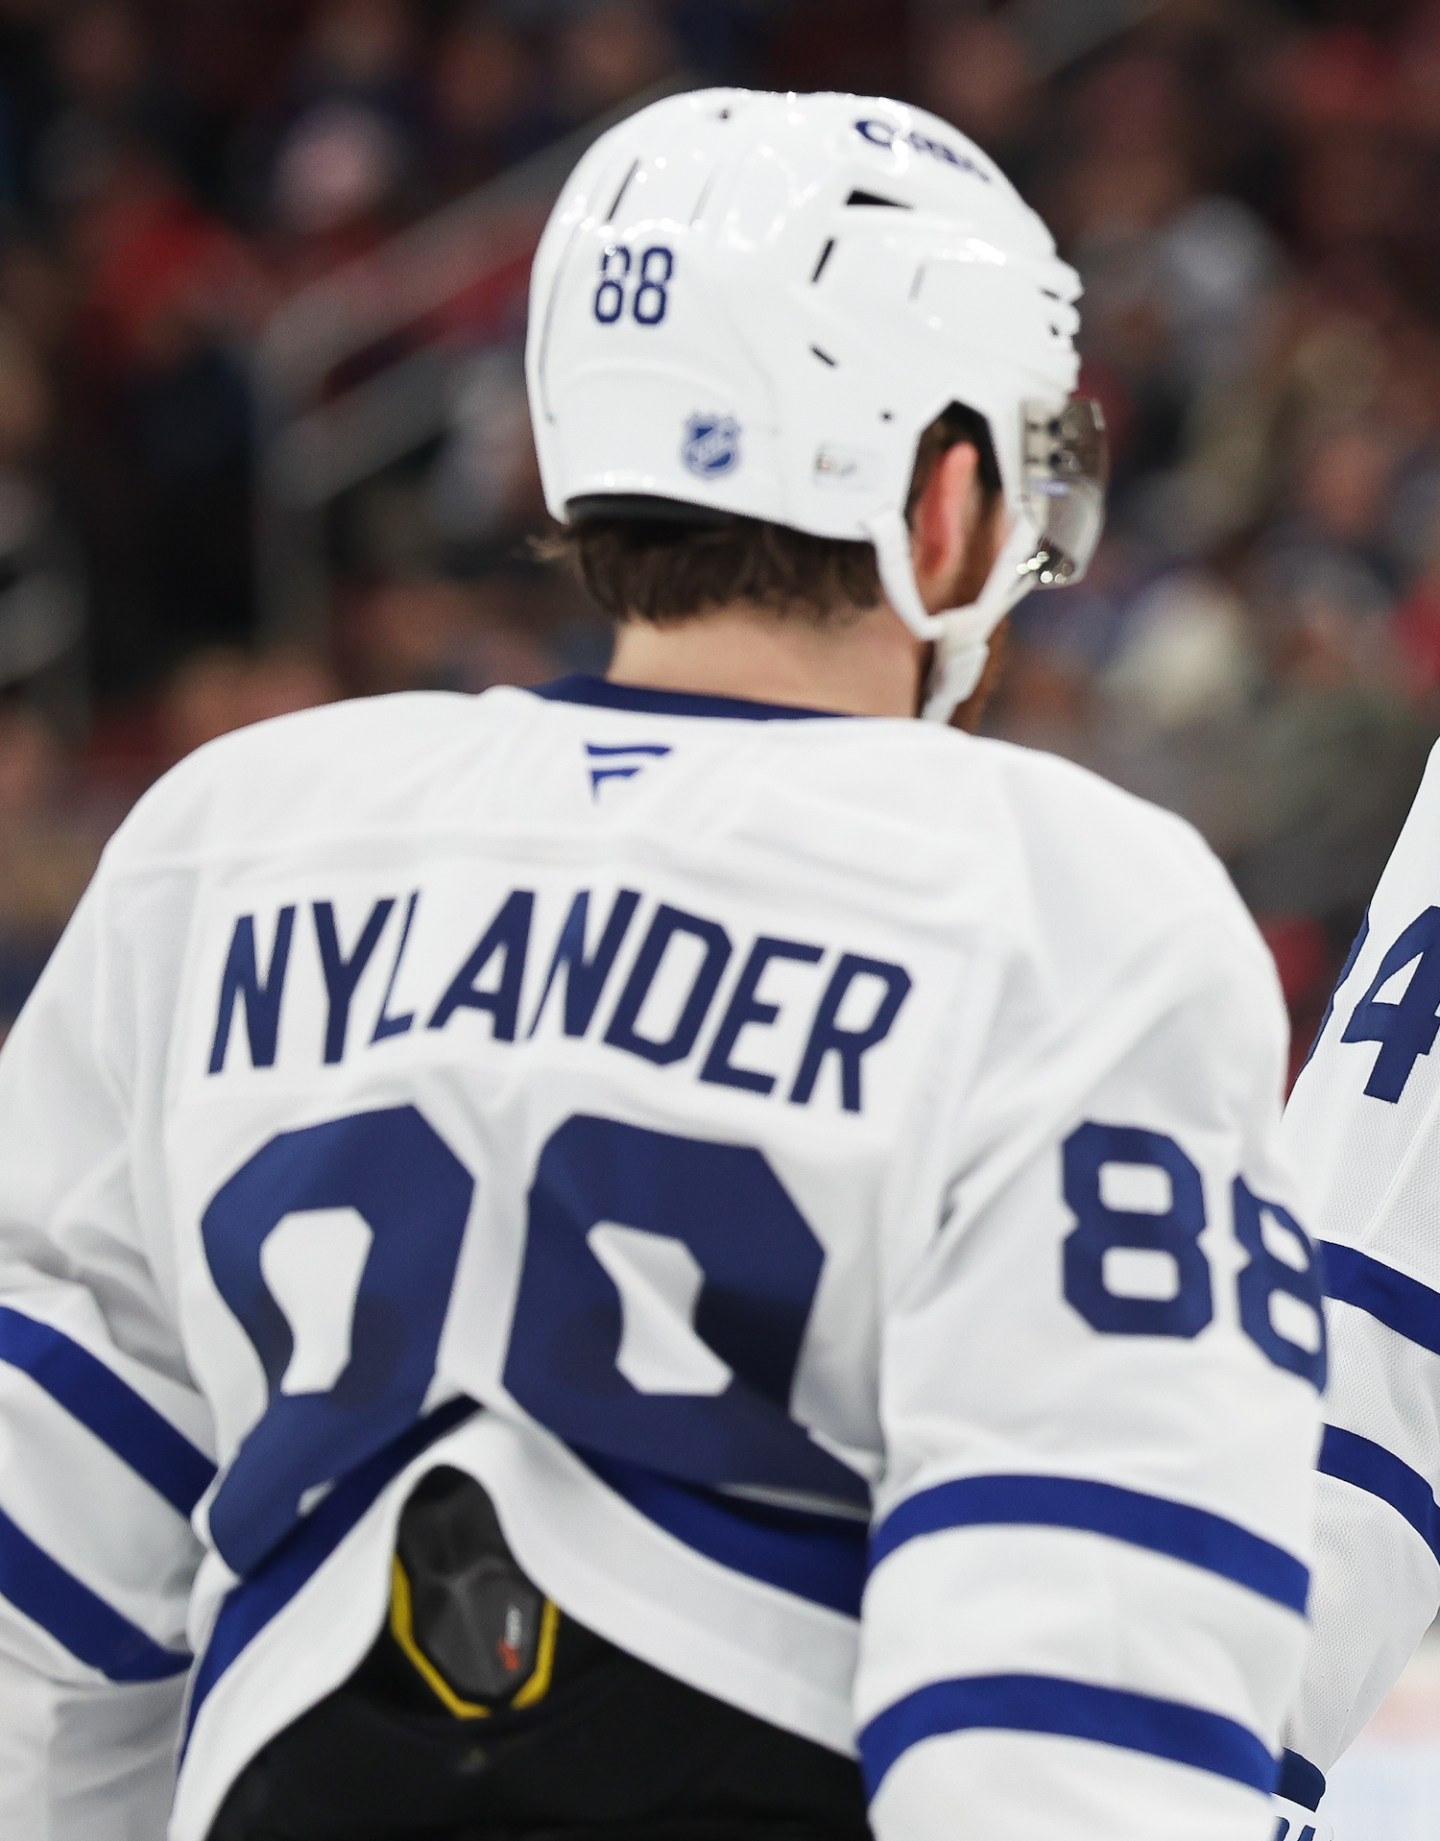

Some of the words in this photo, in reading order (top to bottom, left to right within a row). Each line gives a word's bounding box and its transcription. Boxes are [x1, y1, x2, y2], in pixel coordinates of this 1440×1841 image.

[595, 246, 673, 324] 88
[208, 888, 912, 1113] NYLANDER
[1062, 1121, 1327, 1395] 88
